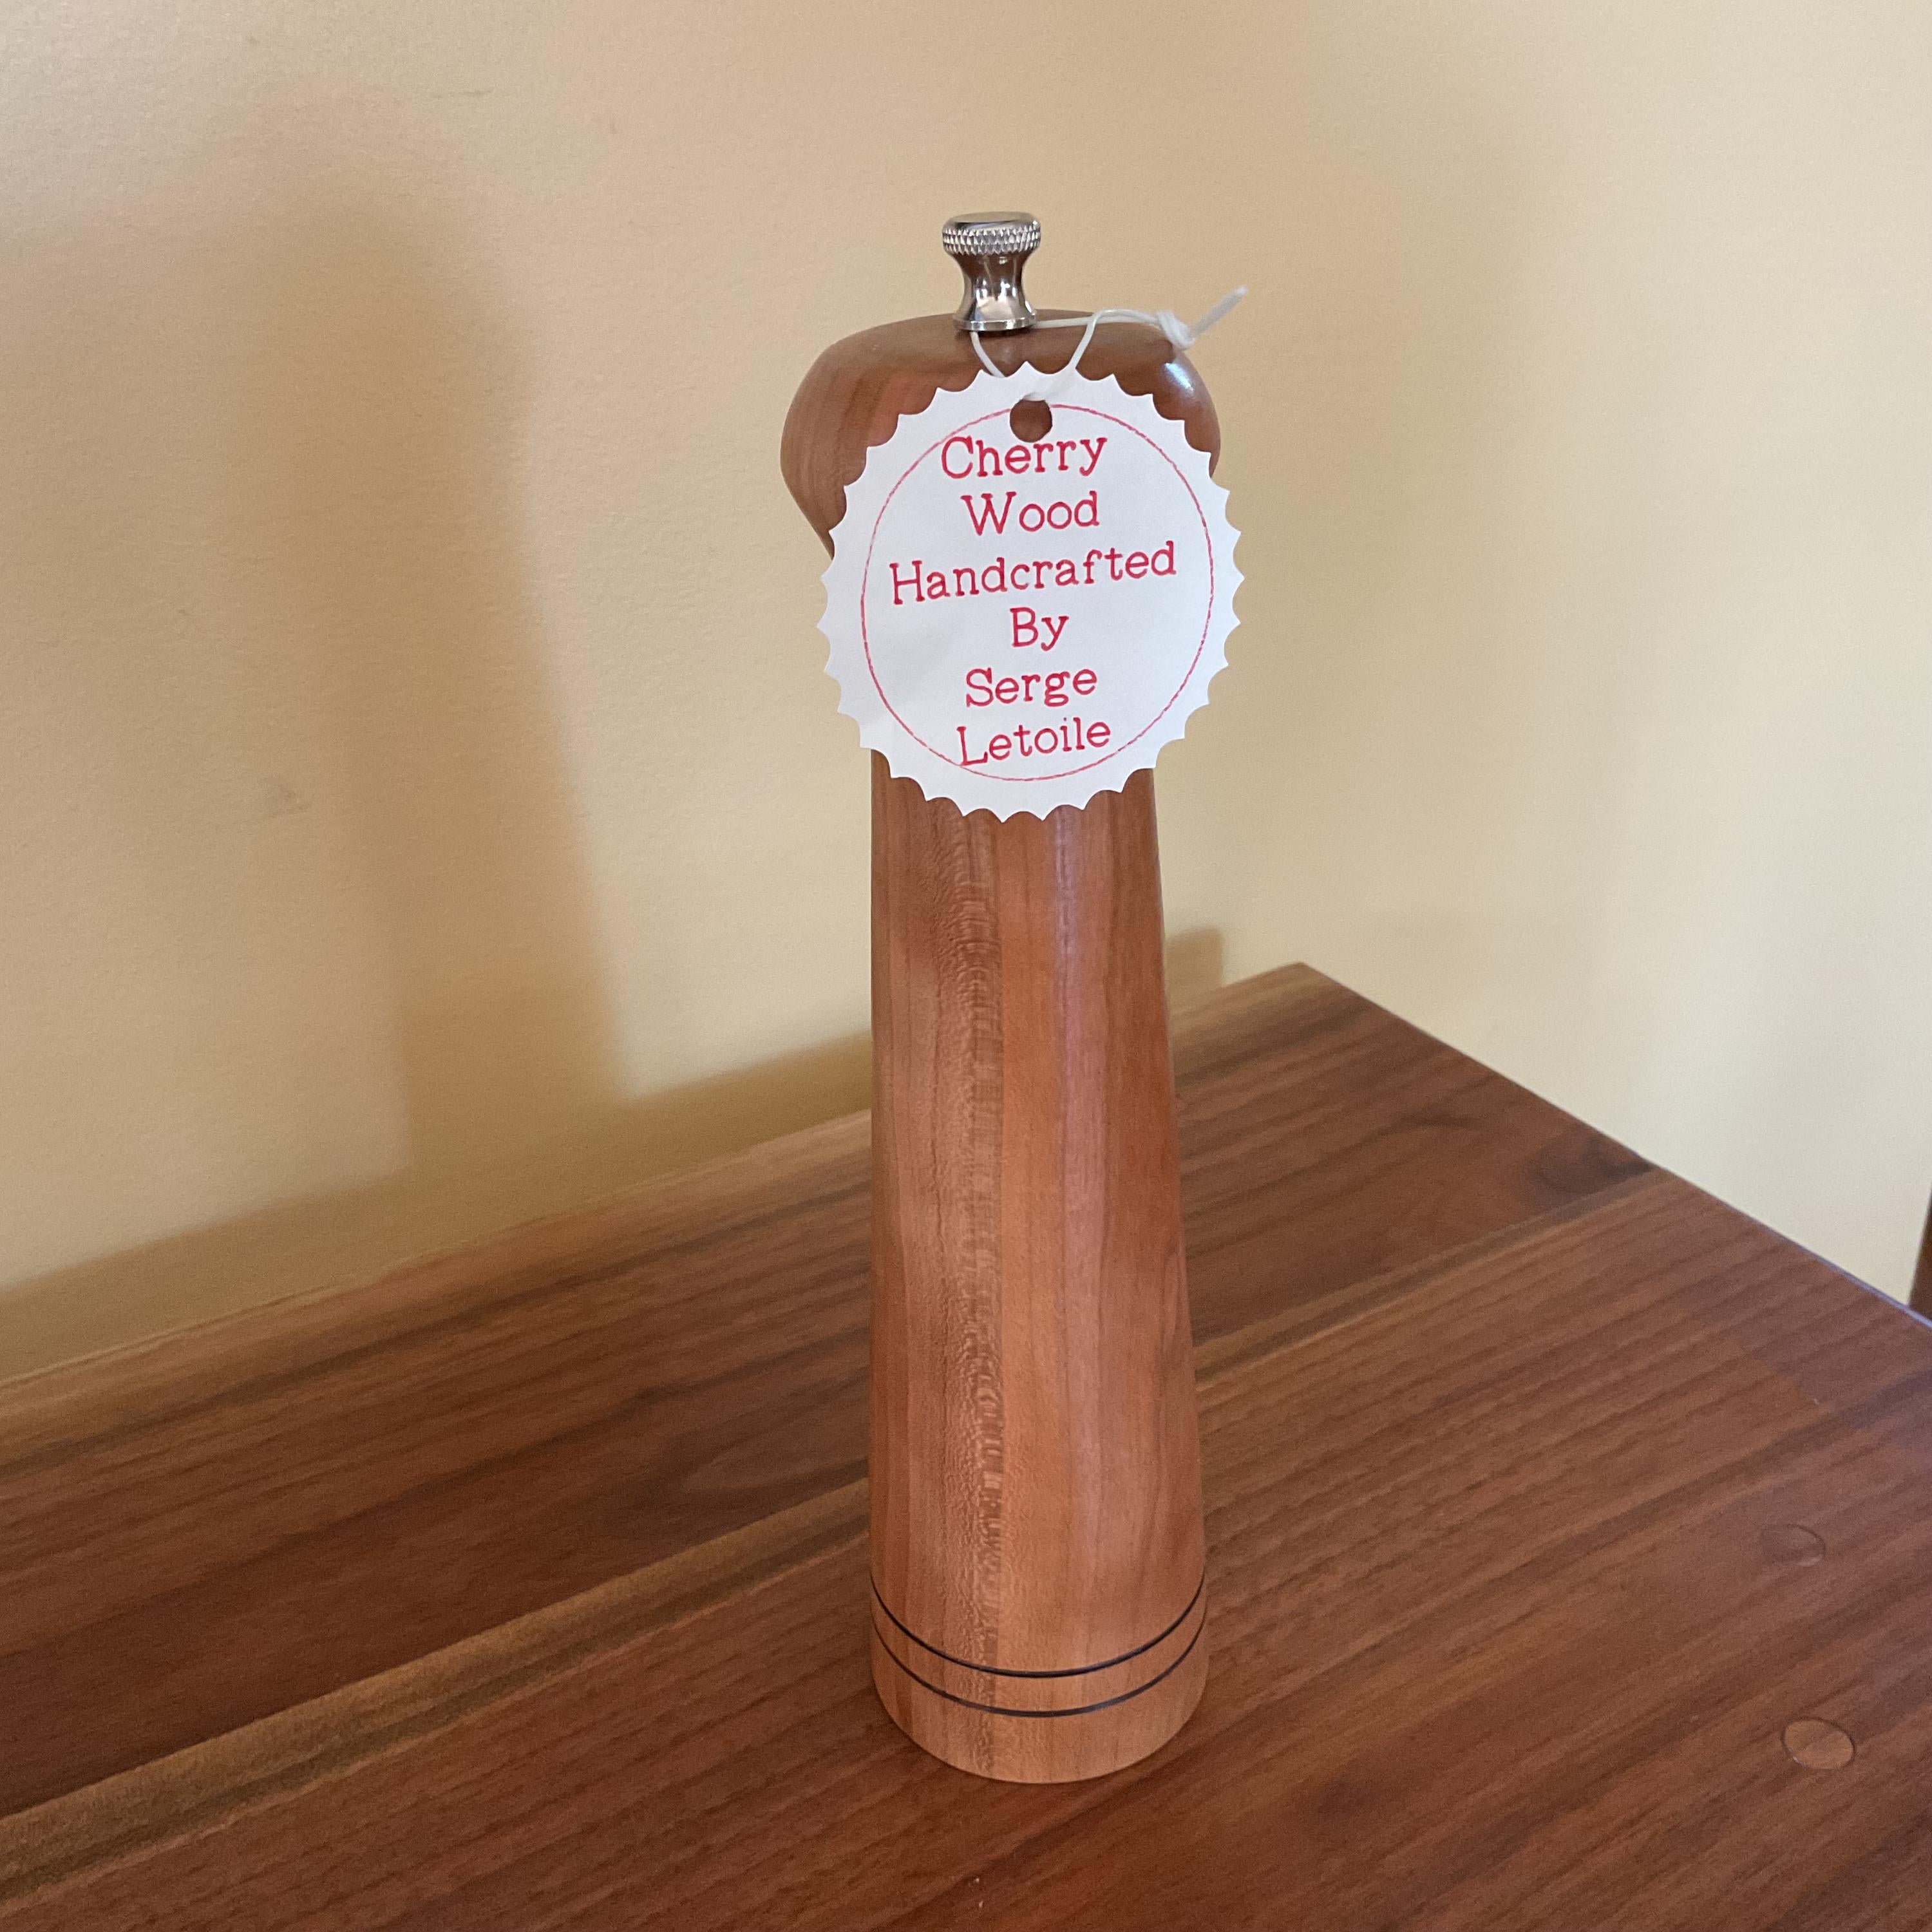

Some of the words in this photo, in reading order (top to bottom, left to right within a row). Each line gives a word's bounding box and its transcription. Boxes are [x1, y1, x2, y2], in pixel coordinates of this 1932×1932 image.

[941, 435, 1108, 480] Cherry
[960, 490, 1100, 536] Wood
[889, 540, 1176, 605] Handcrafted
[1009, 607, 1070, 652] By
[965, 668, 1098, 708] Serge
[956, 717, 1112, 767] Letoile
